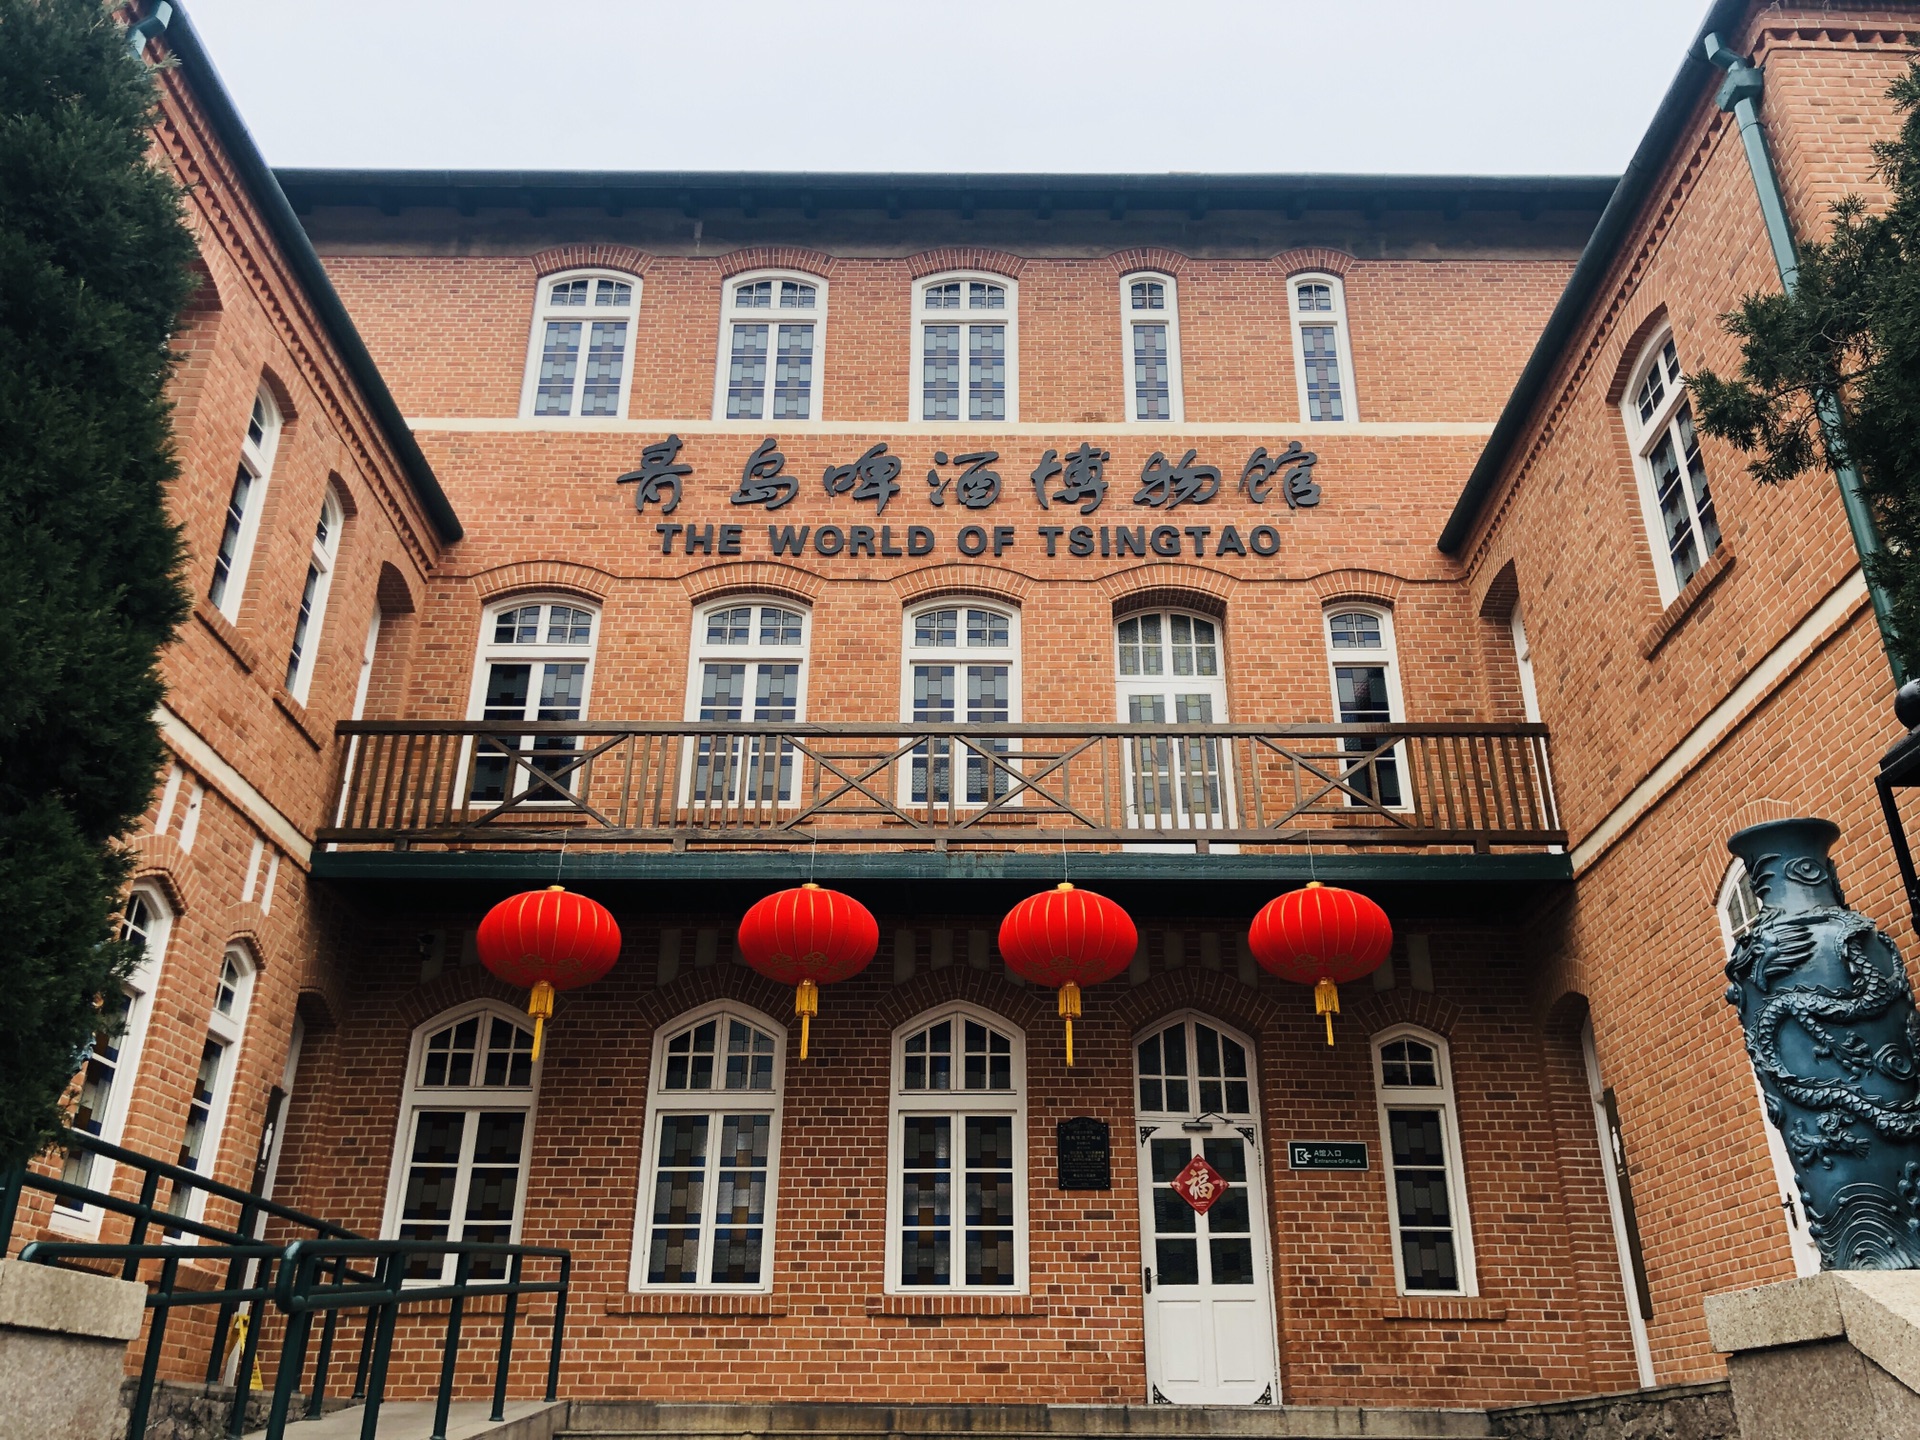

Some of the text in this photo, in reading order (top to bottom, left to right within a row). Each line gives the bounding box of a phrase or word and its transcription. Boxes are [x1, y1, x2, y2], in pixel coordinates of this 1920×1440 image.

[617, 433, 1322, 516] 青岛啤酒博物馆
[656, 523, 1281, 557] THE WORLD OF TSINGTAO
[1314, 1149, 1342, 1157] A馆入口
[1184, 1168, 1215, 1200] 福
